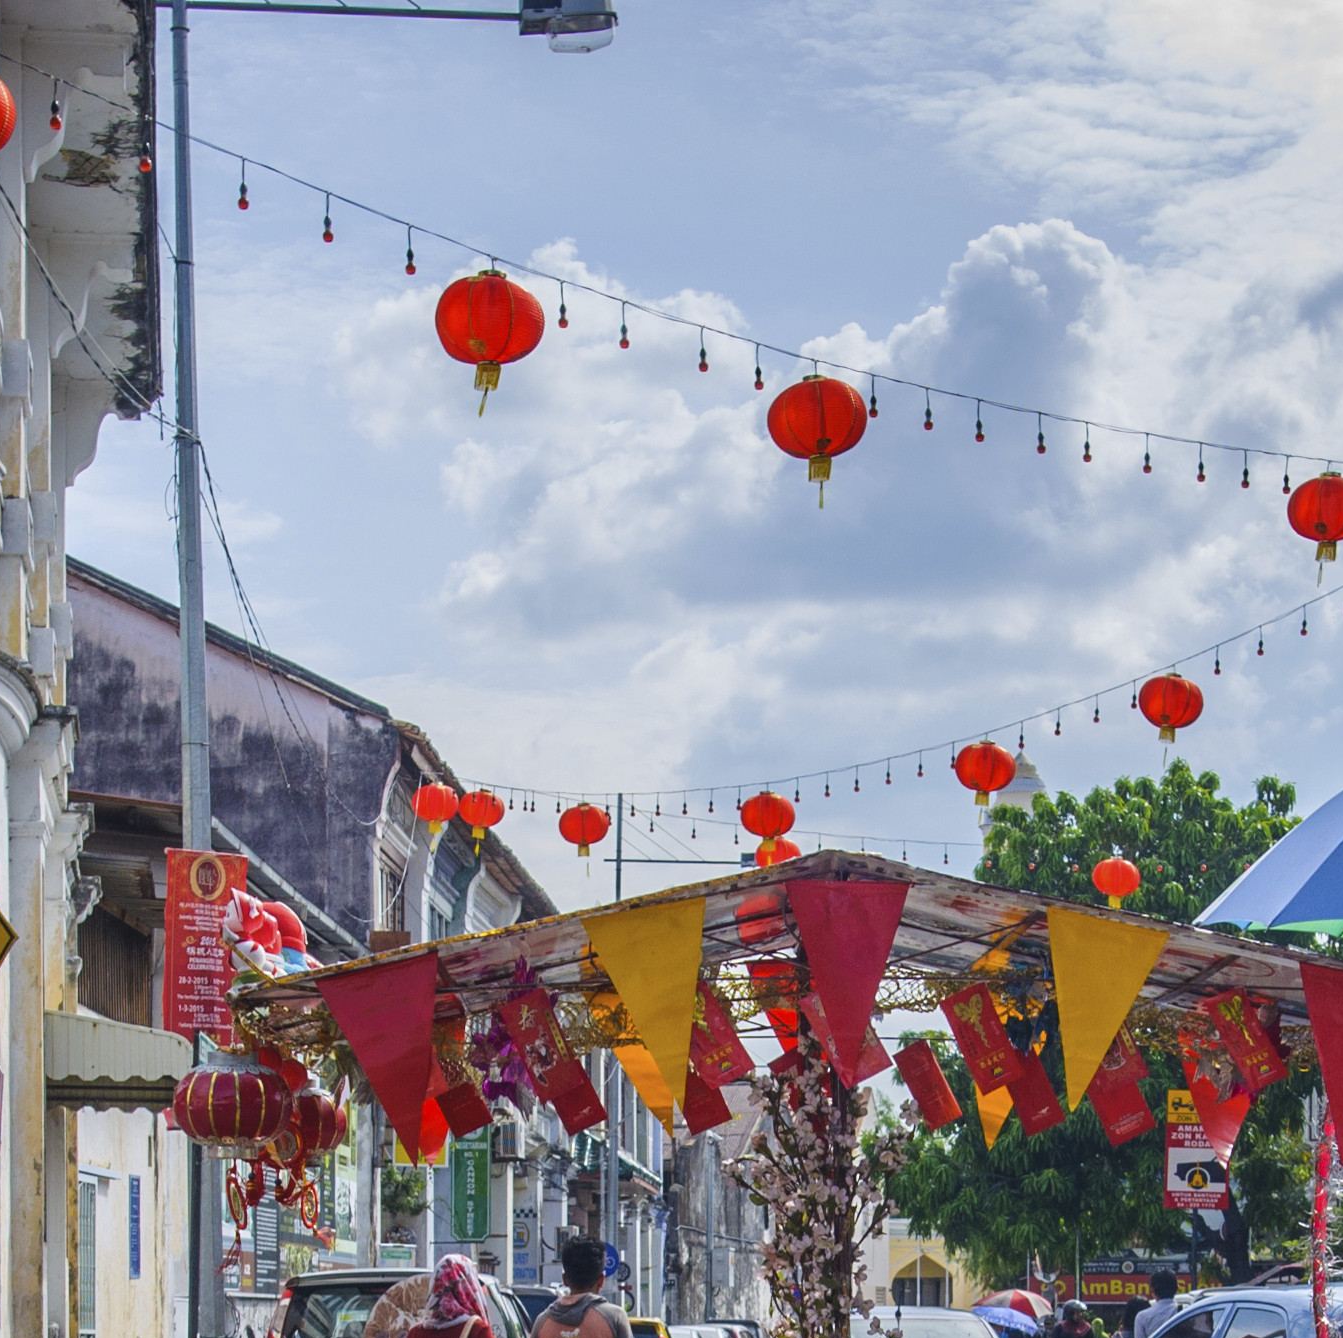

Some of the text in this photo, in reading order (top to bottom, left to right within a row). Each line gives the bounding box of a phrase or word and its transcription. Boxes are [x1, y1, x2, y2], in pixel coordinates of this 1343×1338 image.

[178, 976, 208, 984] 28-2-2015
[178, 1004, 204, 1013] 1-3-2015
[1176, 1114, 1192, 1122] ZON
[455, 1142, 487, 1150] VEGETARIAN
[1184, 1140, 1211, 1148] RODA
[466, 1159, 476, 1195] CANNON
[466, 1201, 475, 1236] STREET
[1081, 1279, 1150, 1295] AmBan
